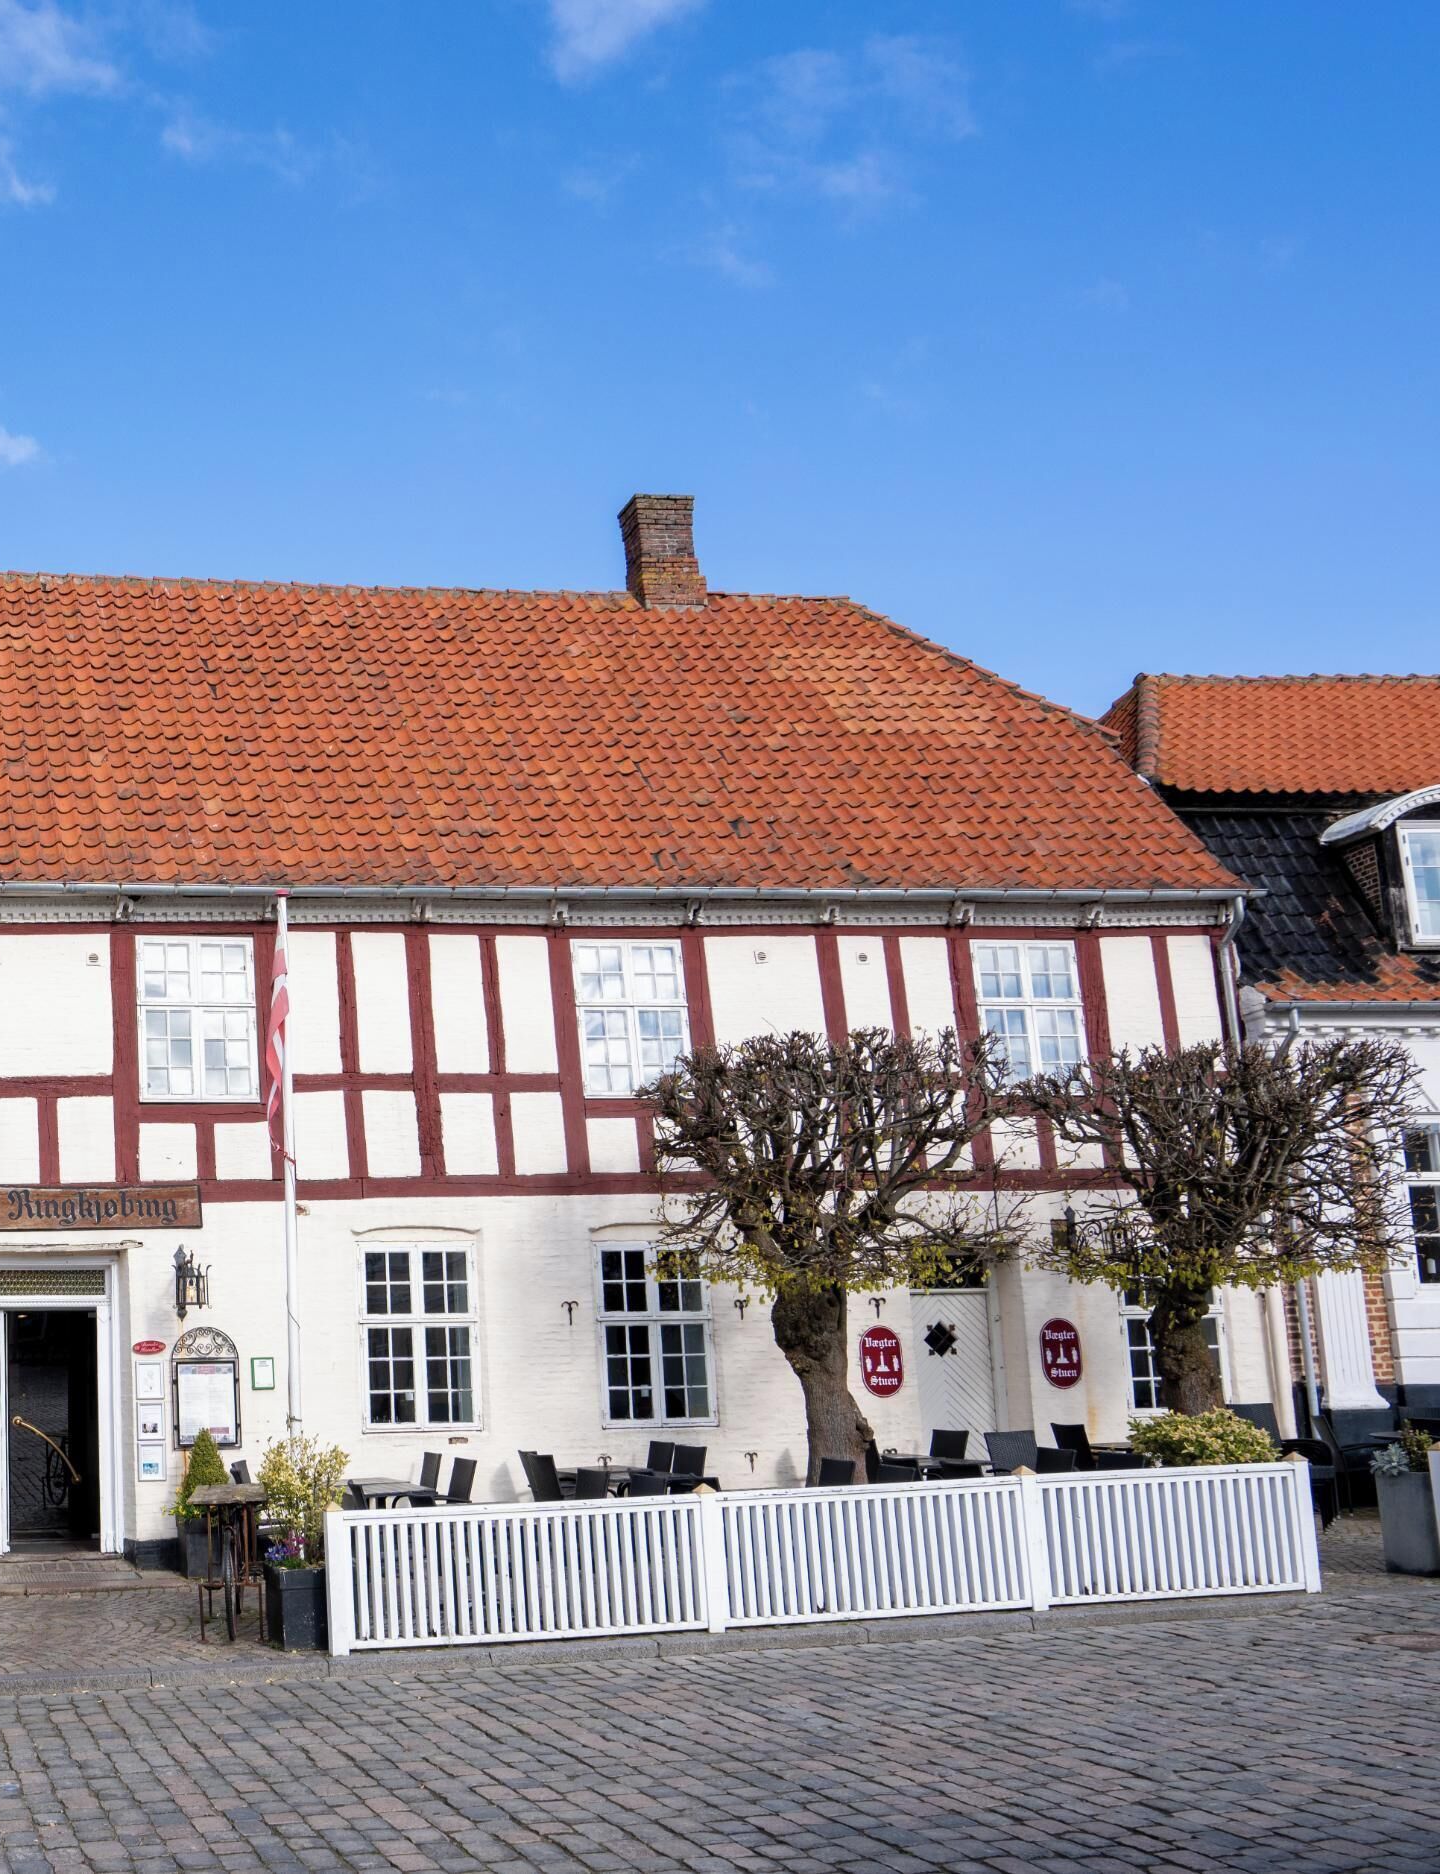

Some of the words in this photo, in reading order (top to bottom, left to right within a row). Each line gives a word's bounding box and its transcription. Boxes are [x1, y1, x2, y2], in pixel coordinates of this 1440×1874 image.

[7, 1189, 178, 1226] Ringkjøbing
[1044, 1330, 1076, 1341] Vægter
[864, 1337, 897, 1349] Vægter
[1051, 1367, 1077, 1377] Stuen
[870, 1375, 898, 1386] Stuen
